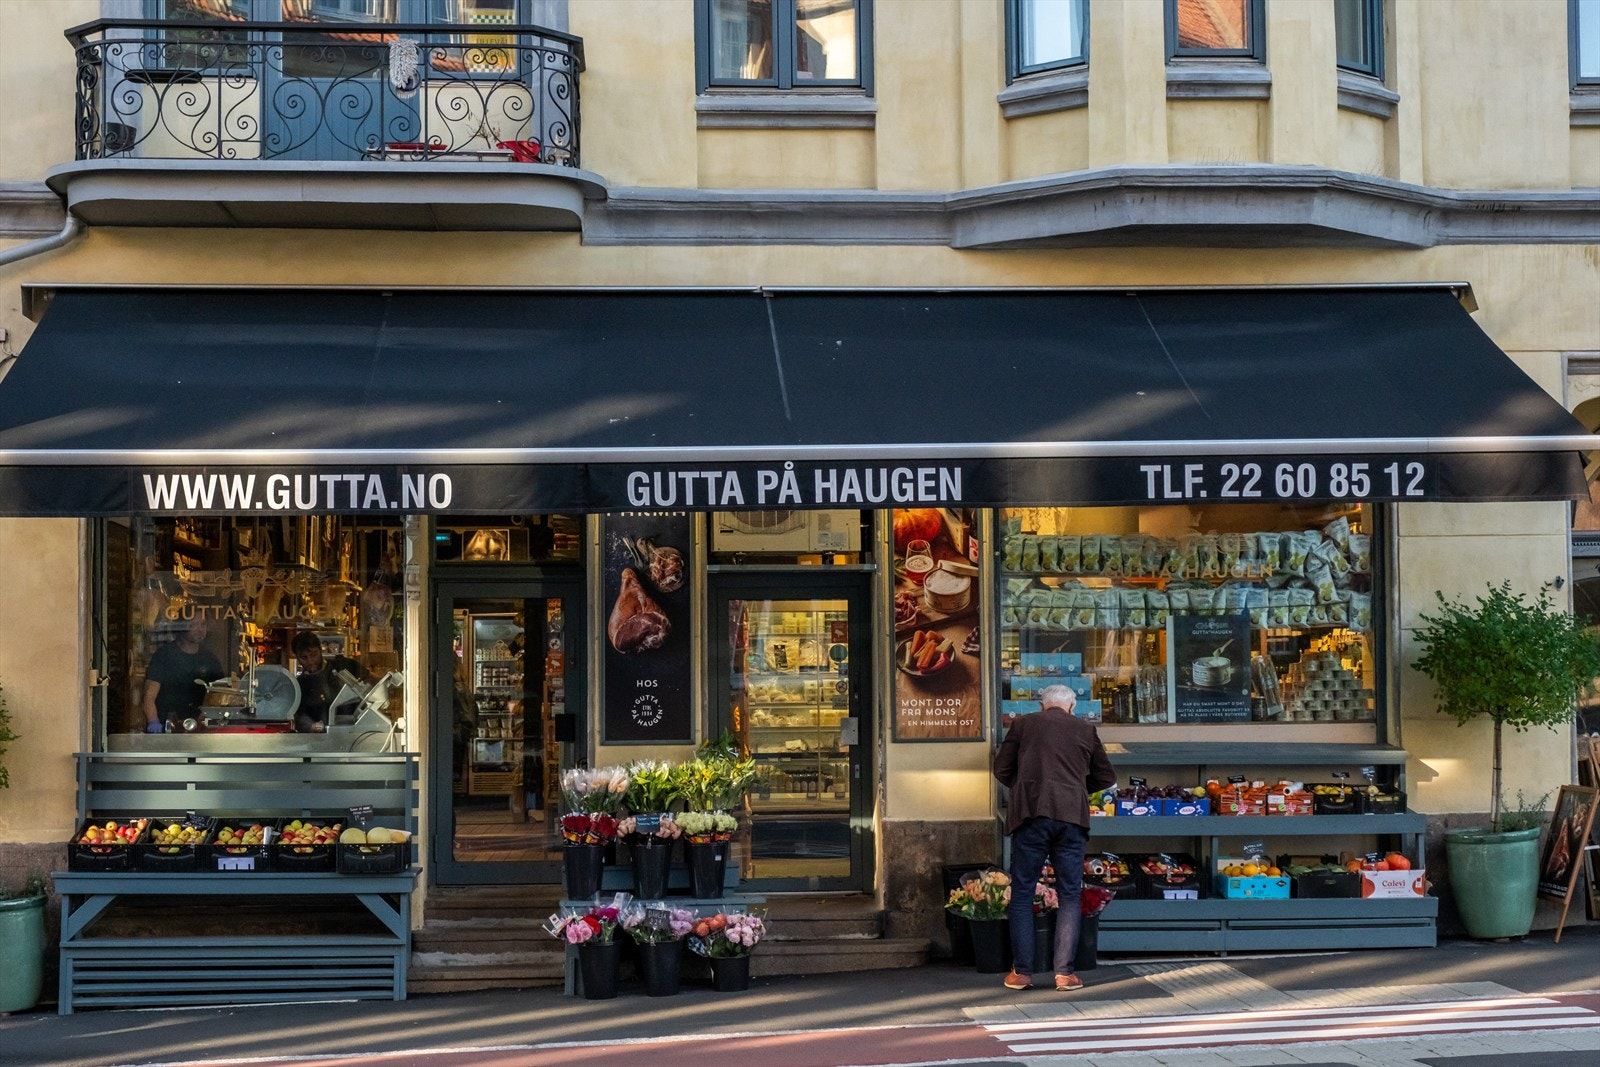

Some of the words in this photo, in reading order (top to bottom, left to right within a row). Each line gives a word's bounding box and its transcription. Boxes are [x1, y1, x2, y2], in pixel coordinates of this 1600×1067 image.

[626, 470, 745, 507] GUTTA
[756, 461, 803, 505] PÅ
[813, 466, 963, 504] HAUGEN
[1139, 463, 1208, 499] TLF.
[1220, 462, 1262, 497] 22
[1275, 462, 1317, 498] 60
[1329, 462, 1371, 498] 85
[1384, 461, 1425, 496] 12
[142, 473, 453, 511] WWW.GUTTA.NO
[1185, 563, 1273, 579] HAUGEN
[164, 604, 237, 621] GUTTA
[252, 603, 344, 620] HAUGE
[636, 679, 658, 688] HOS
[634, 694, 659, 705] GUTTA
[901, 698, 933, 707] MONT
[935, 698, 962, 707] D'OR
[631, 709, 640, 720] PÅ
[637, 709, 664, 727] HAUGEN
[901, 708, 921, 716] FRA
[925, 708, 956, 716] MONS
